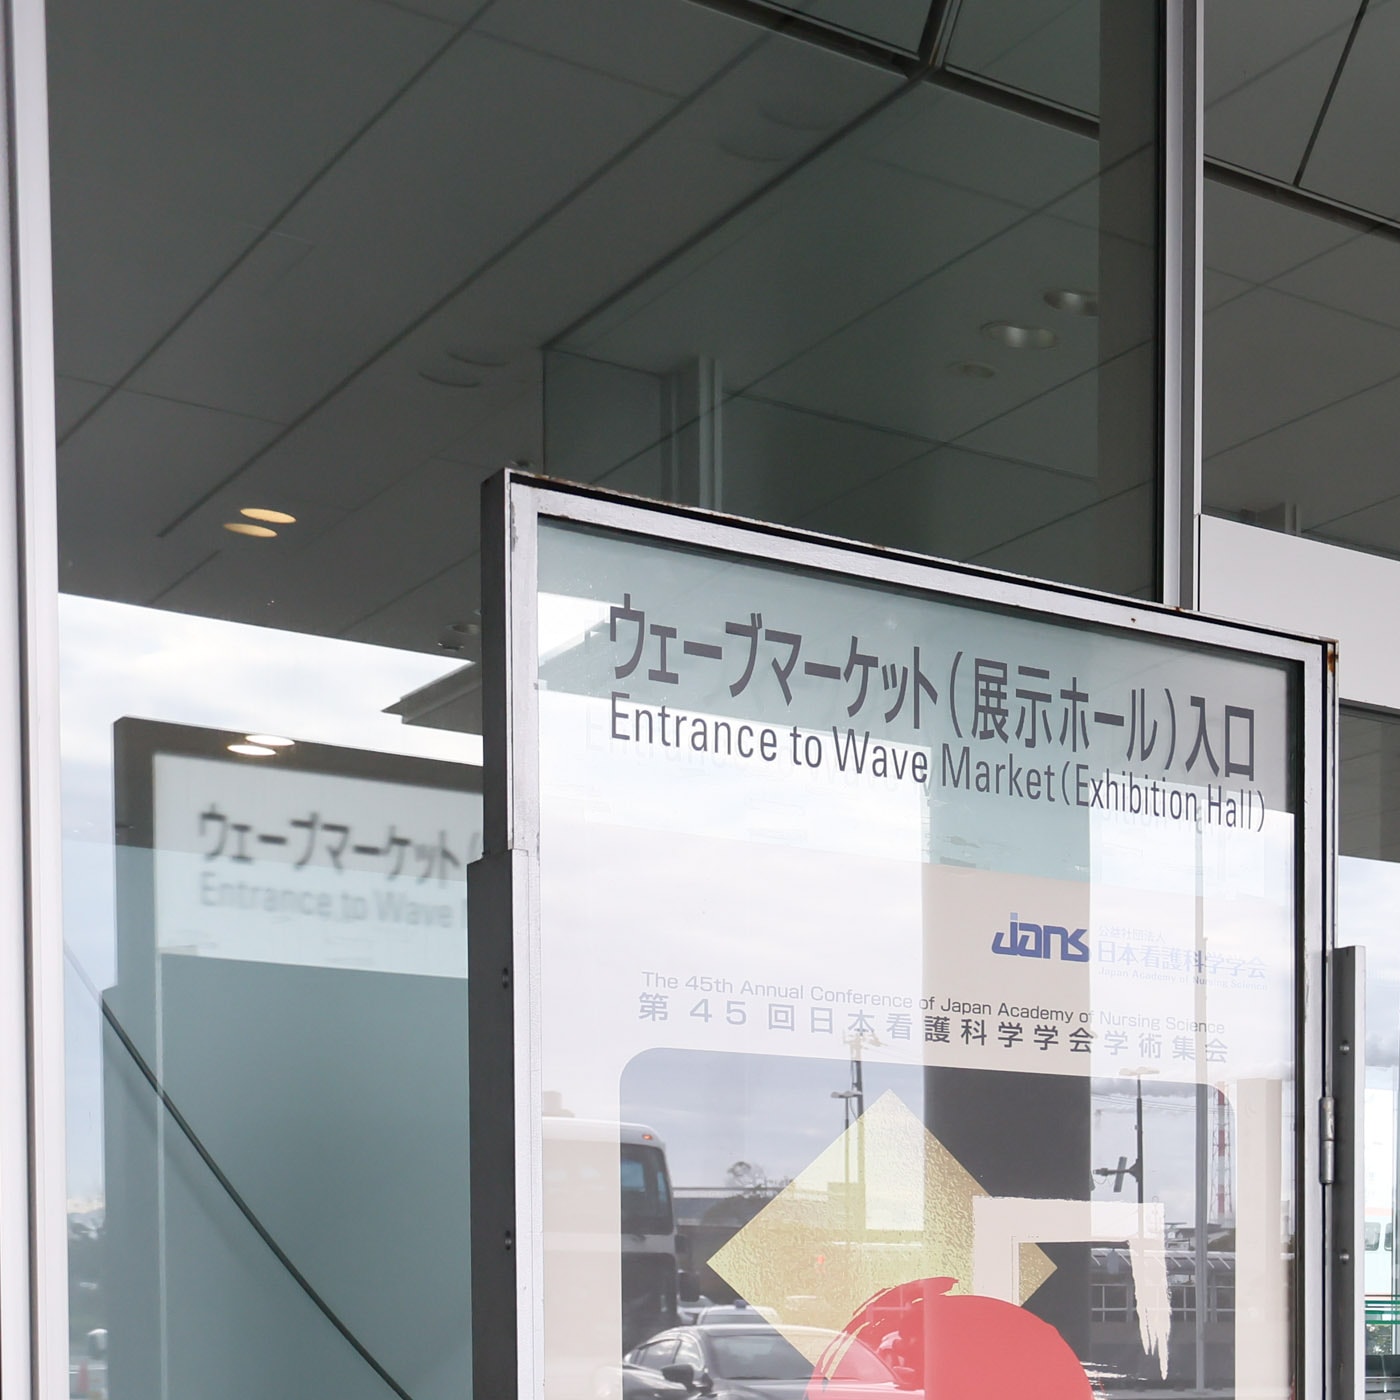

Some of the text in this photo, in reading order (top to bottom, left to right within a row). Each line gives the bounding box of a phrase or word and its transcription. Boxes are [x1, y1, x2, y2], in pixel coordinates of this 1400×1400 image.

[609, 592, 1255, 782] ウェーブマーケット（展示ホール）入口
[610, 690, 778, 762] Entrance
[789, 725, 823, 768] to
[831, 725, 929, 783] Wave
[1207, 783, 1265, 832] Hall)
[641, 971, 1225, 1034] The 45th Annual Conference of Japan Academy of Nursing Science
[1096, 939, 1267, 980] 日本看護科学学会
